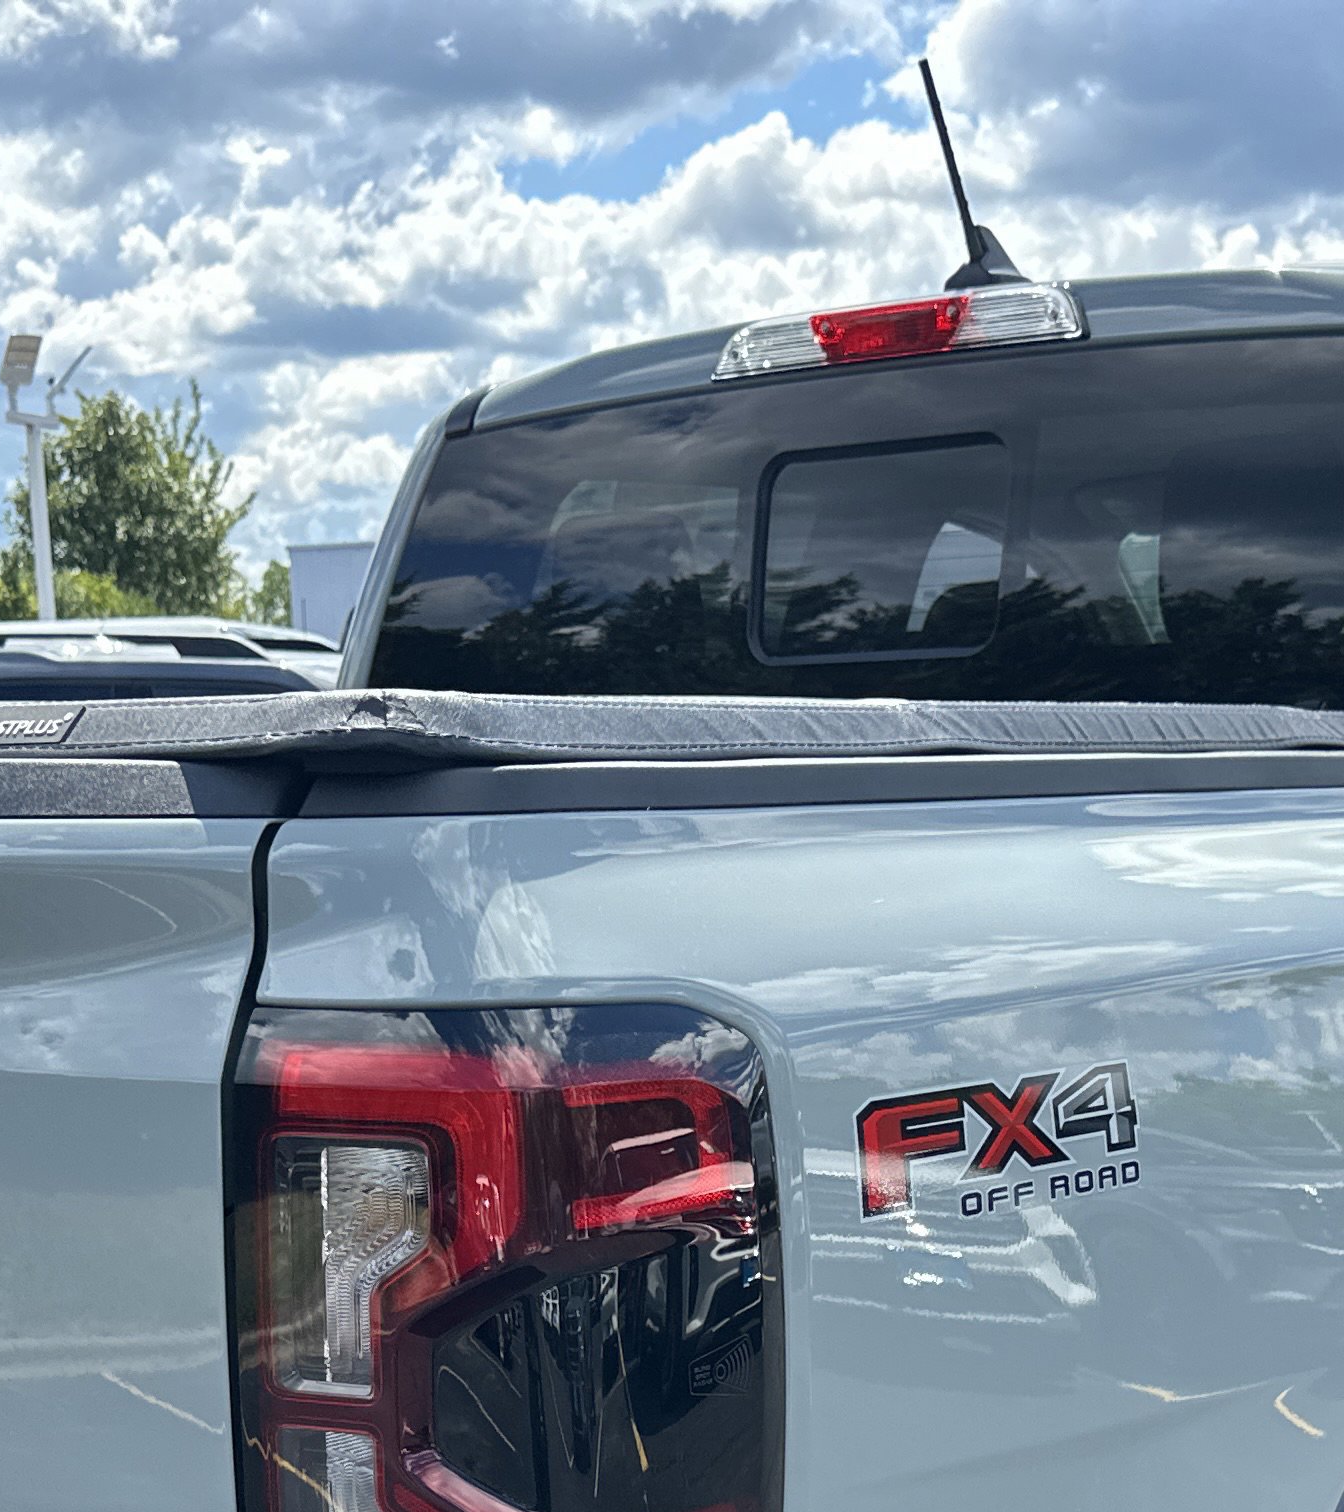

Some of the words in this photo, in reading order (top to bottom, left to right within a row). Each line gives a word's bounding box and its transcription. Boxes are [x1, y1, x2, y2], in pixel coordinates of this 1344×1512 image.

[855, 1060, 1138, 1221] FX4
[960, 1181, 1034, 1217] OFF
[1049, 1160, 1140, 1199] ROAD
